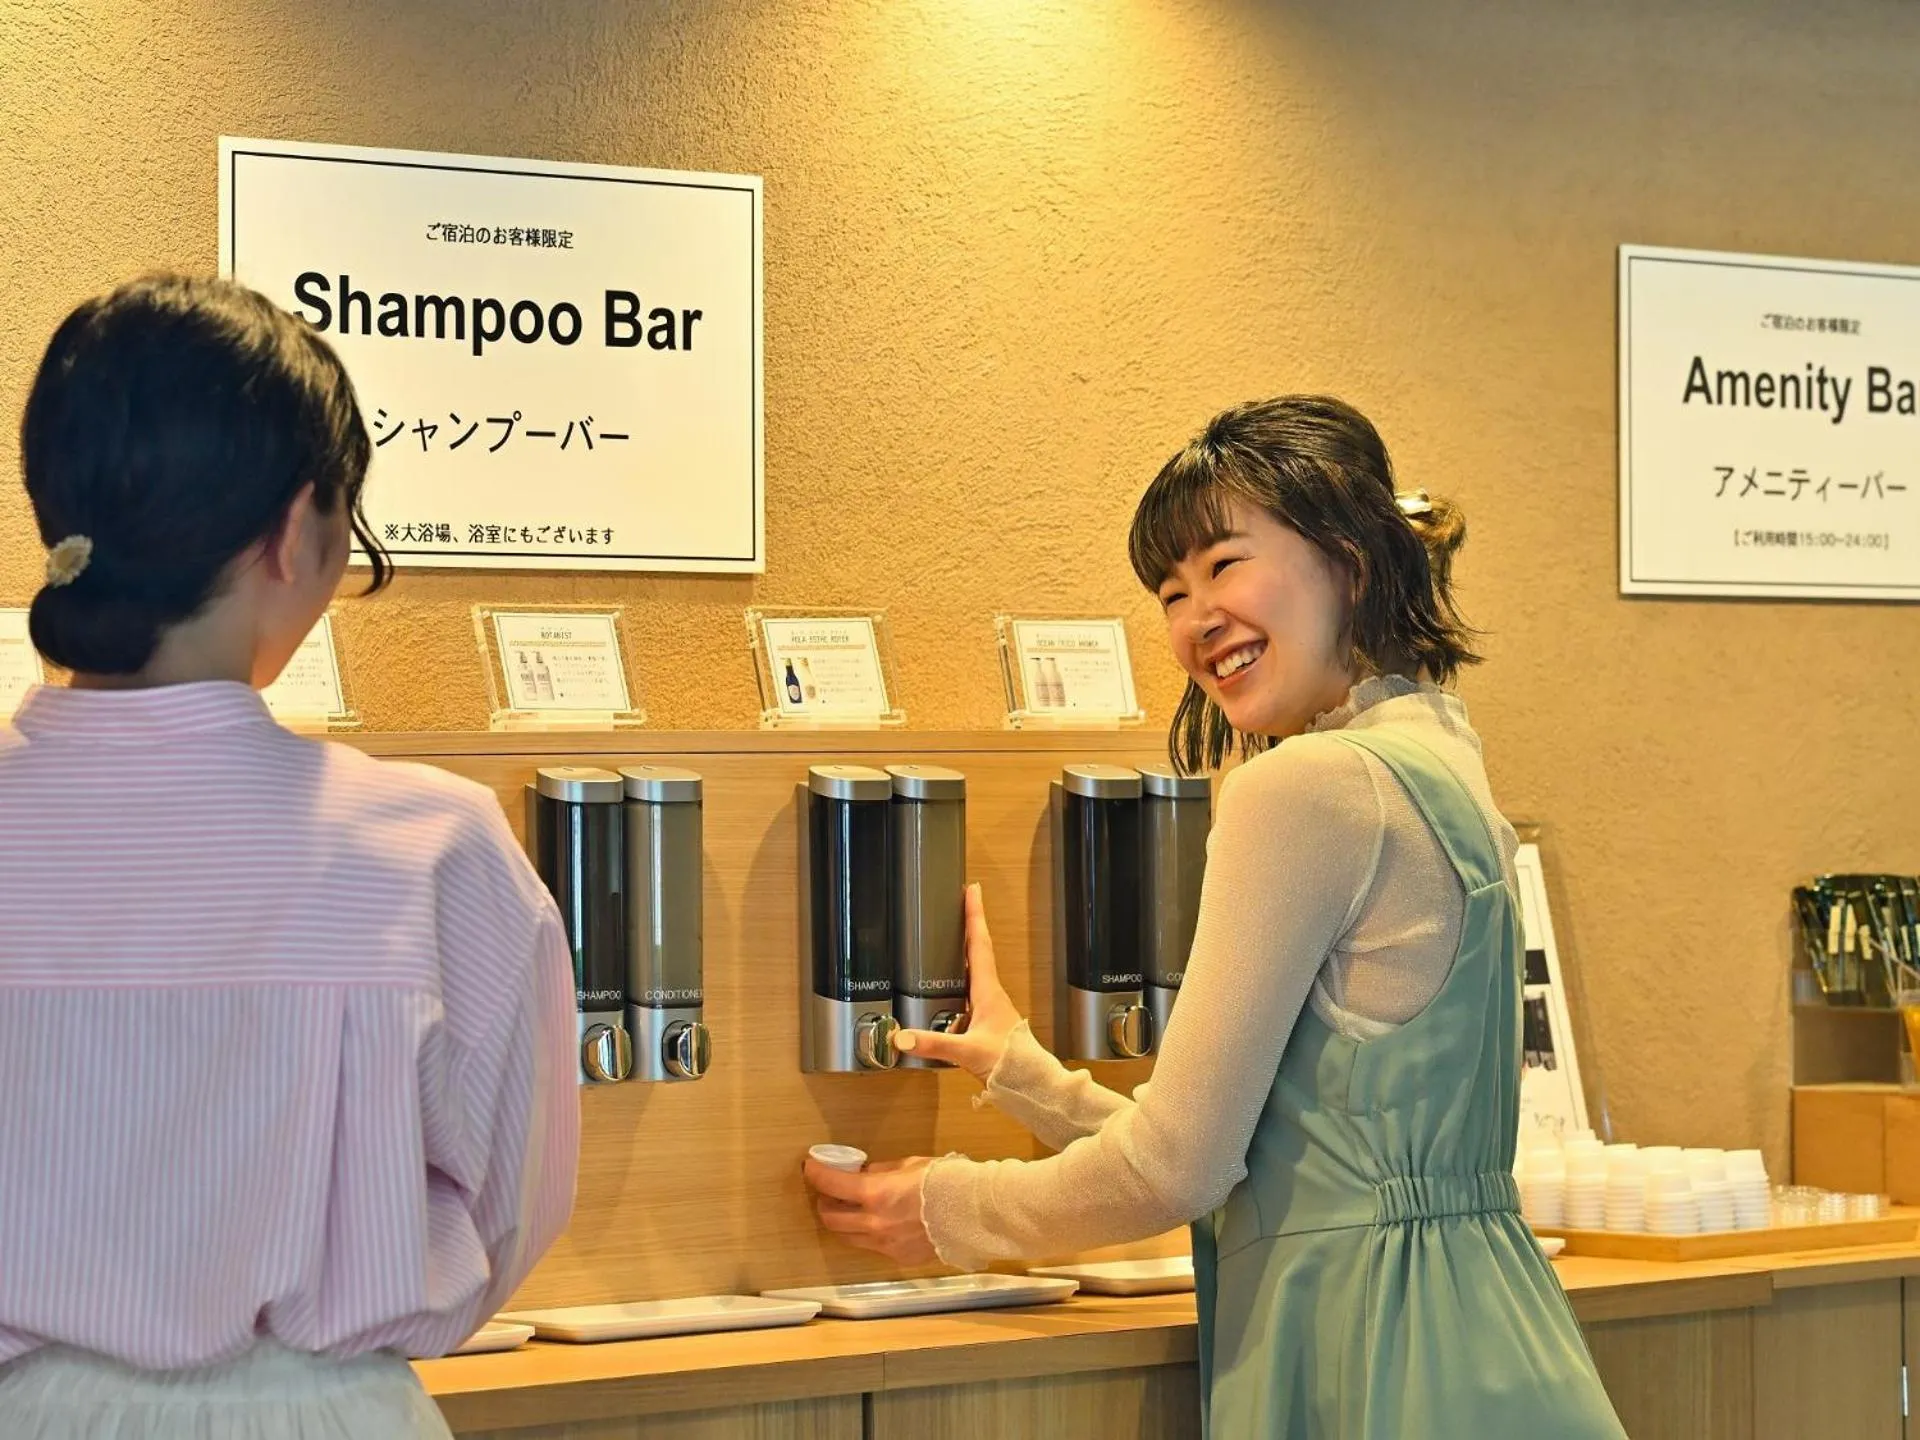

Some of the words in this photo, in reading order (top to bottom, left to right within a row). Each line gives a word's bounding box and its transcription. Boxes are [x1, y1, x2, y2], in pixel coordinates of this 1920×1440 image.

[426, 222, 574, 250] ご宿泊のお客様限定
[293, 271, 582, 356] Shampoo
[604, 289, 703, 351] Bar
[1682, 355, 1852, 425] Amenity
[1867, 366, 1920, 415] Ba
[373, 408, 630, 453] シャンプーバー
[1714, 466, 1907, 502] アメニティーバー
[384, 522, 615, 545] ※大浴場、浴室にもございます
[848, 980, 892, 991] SHAMPOO
[918, 979, 966, 990] CONDITION
[1101, 973, 1143, 984] SHAMPOO
[576, 990, 622, 1000] SHAMPOO
[644, 989, 703, 1001] CONDITIONE
